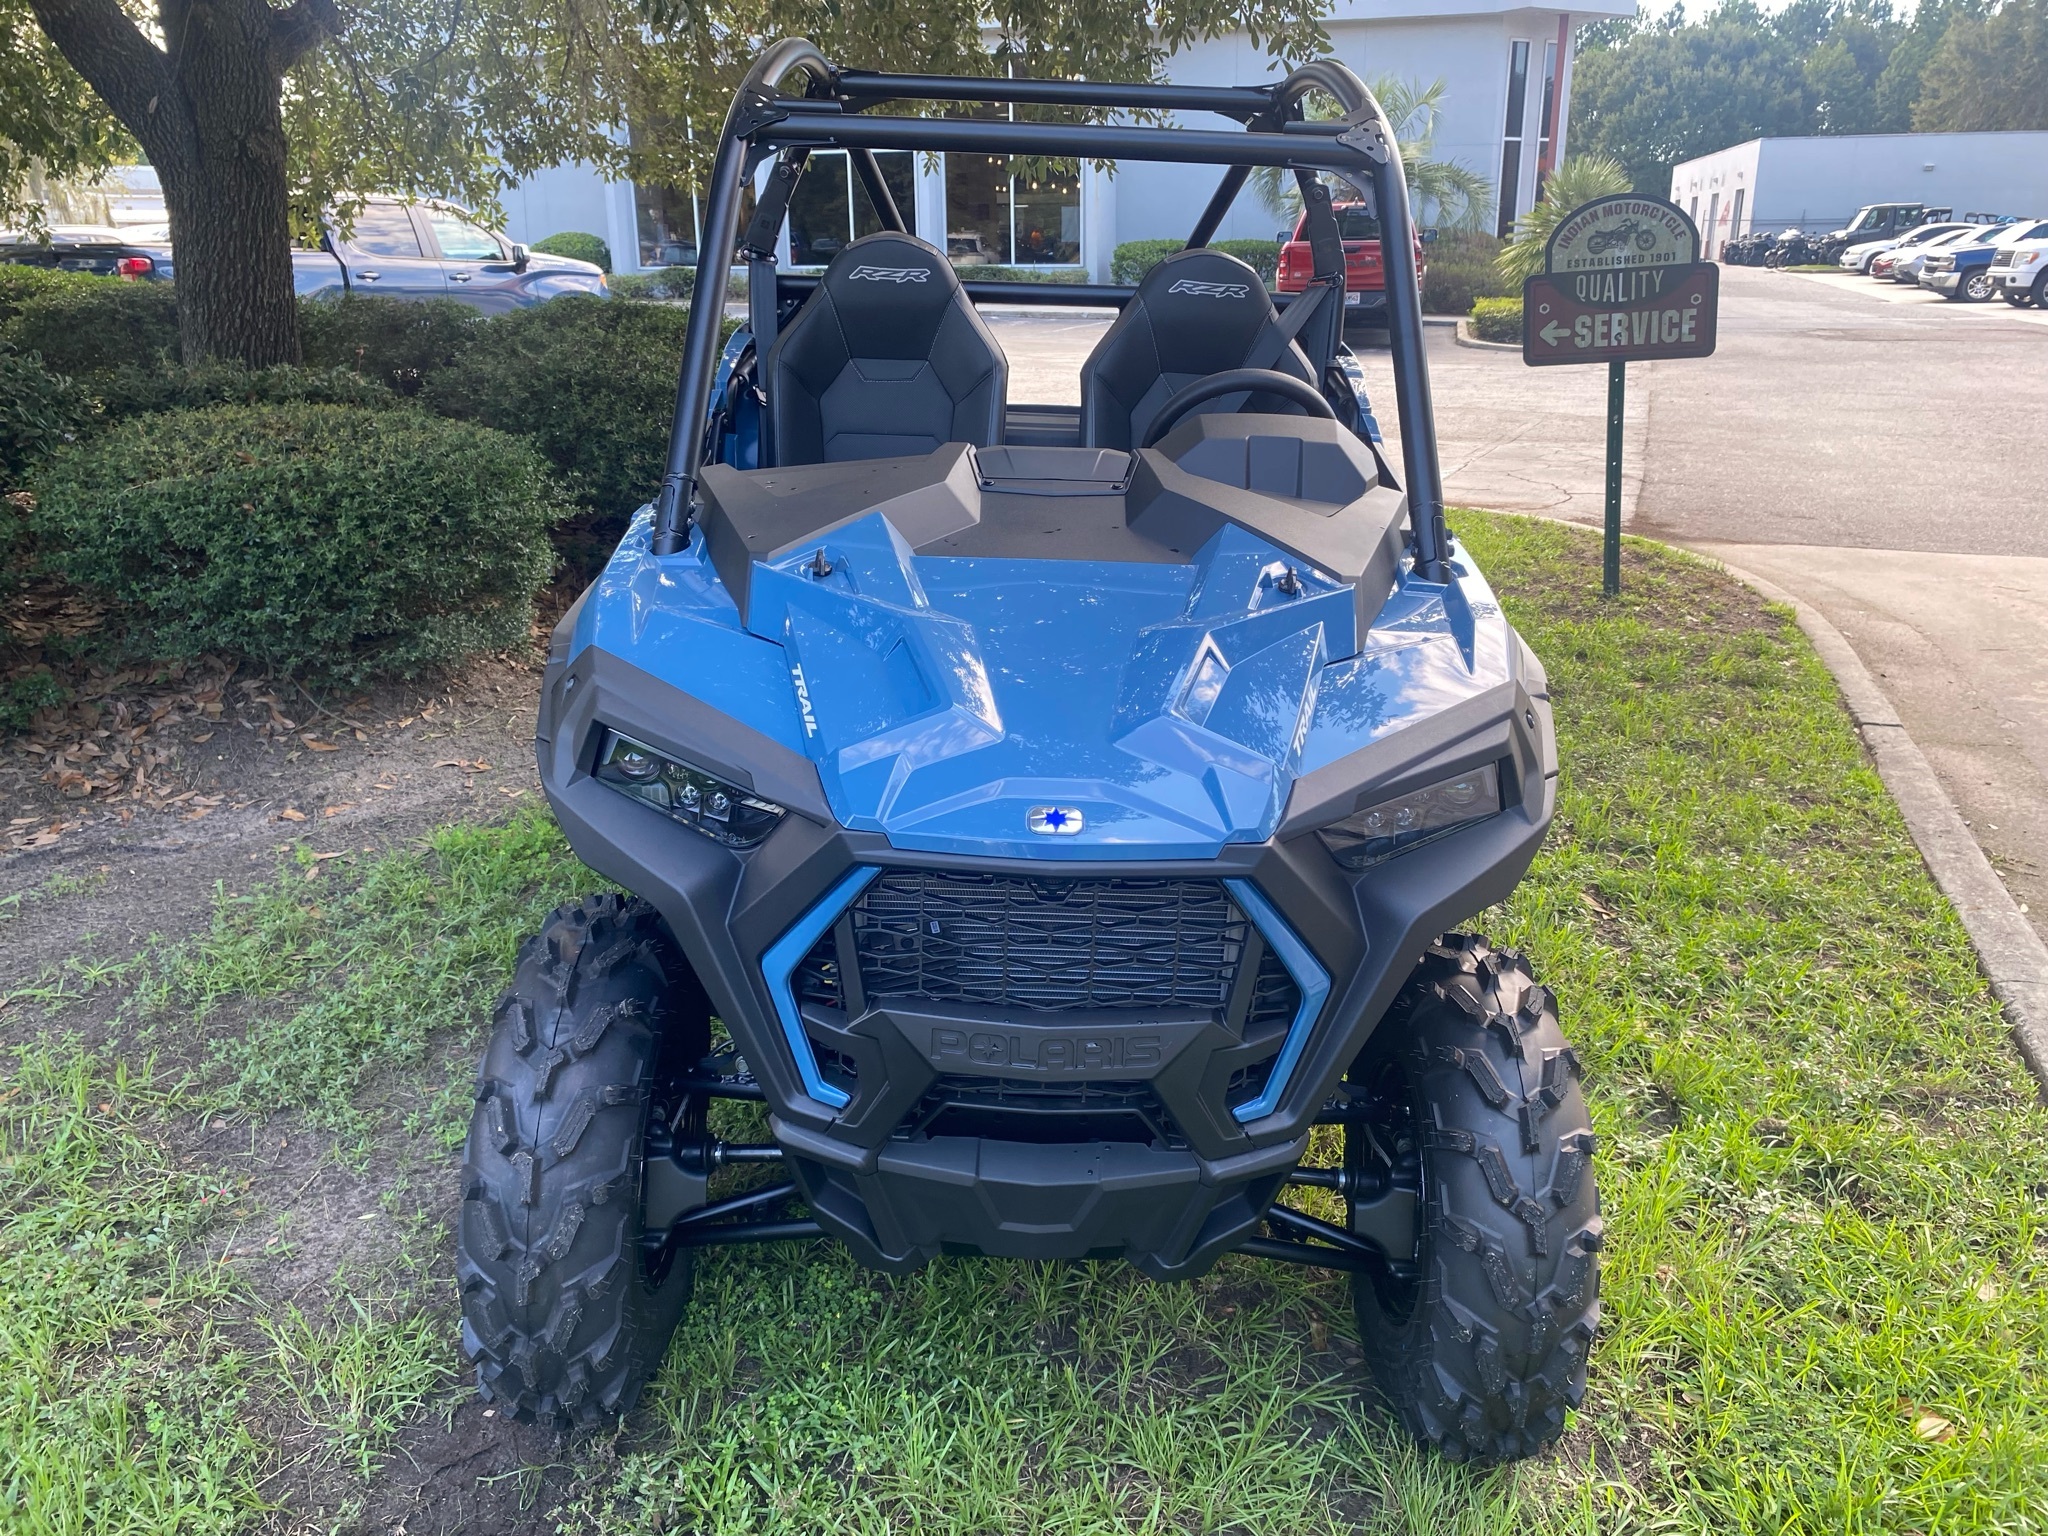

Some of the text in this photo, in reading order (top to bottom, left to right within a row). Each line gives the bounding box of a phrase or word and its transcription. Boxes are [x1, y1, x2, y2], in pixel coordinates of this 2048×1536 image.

[1558, 202, 1687, 249] INDIAN MOTORCYCLE
[849, 265, 931, 283] RZR
[1567, 252, 1676, 269] ESTABLISHED 1901
[1168, 279, 1249, 298] RZR
[1576, 270, 1664, 302] QUALITY
[1574, 308, 1697, 348] SERVICE
[791, 662, 818, 738] TRAIL
[1293, 684, 1317, 757] TRAIL
[931, 1028, 1161, 1071] POLARIS
